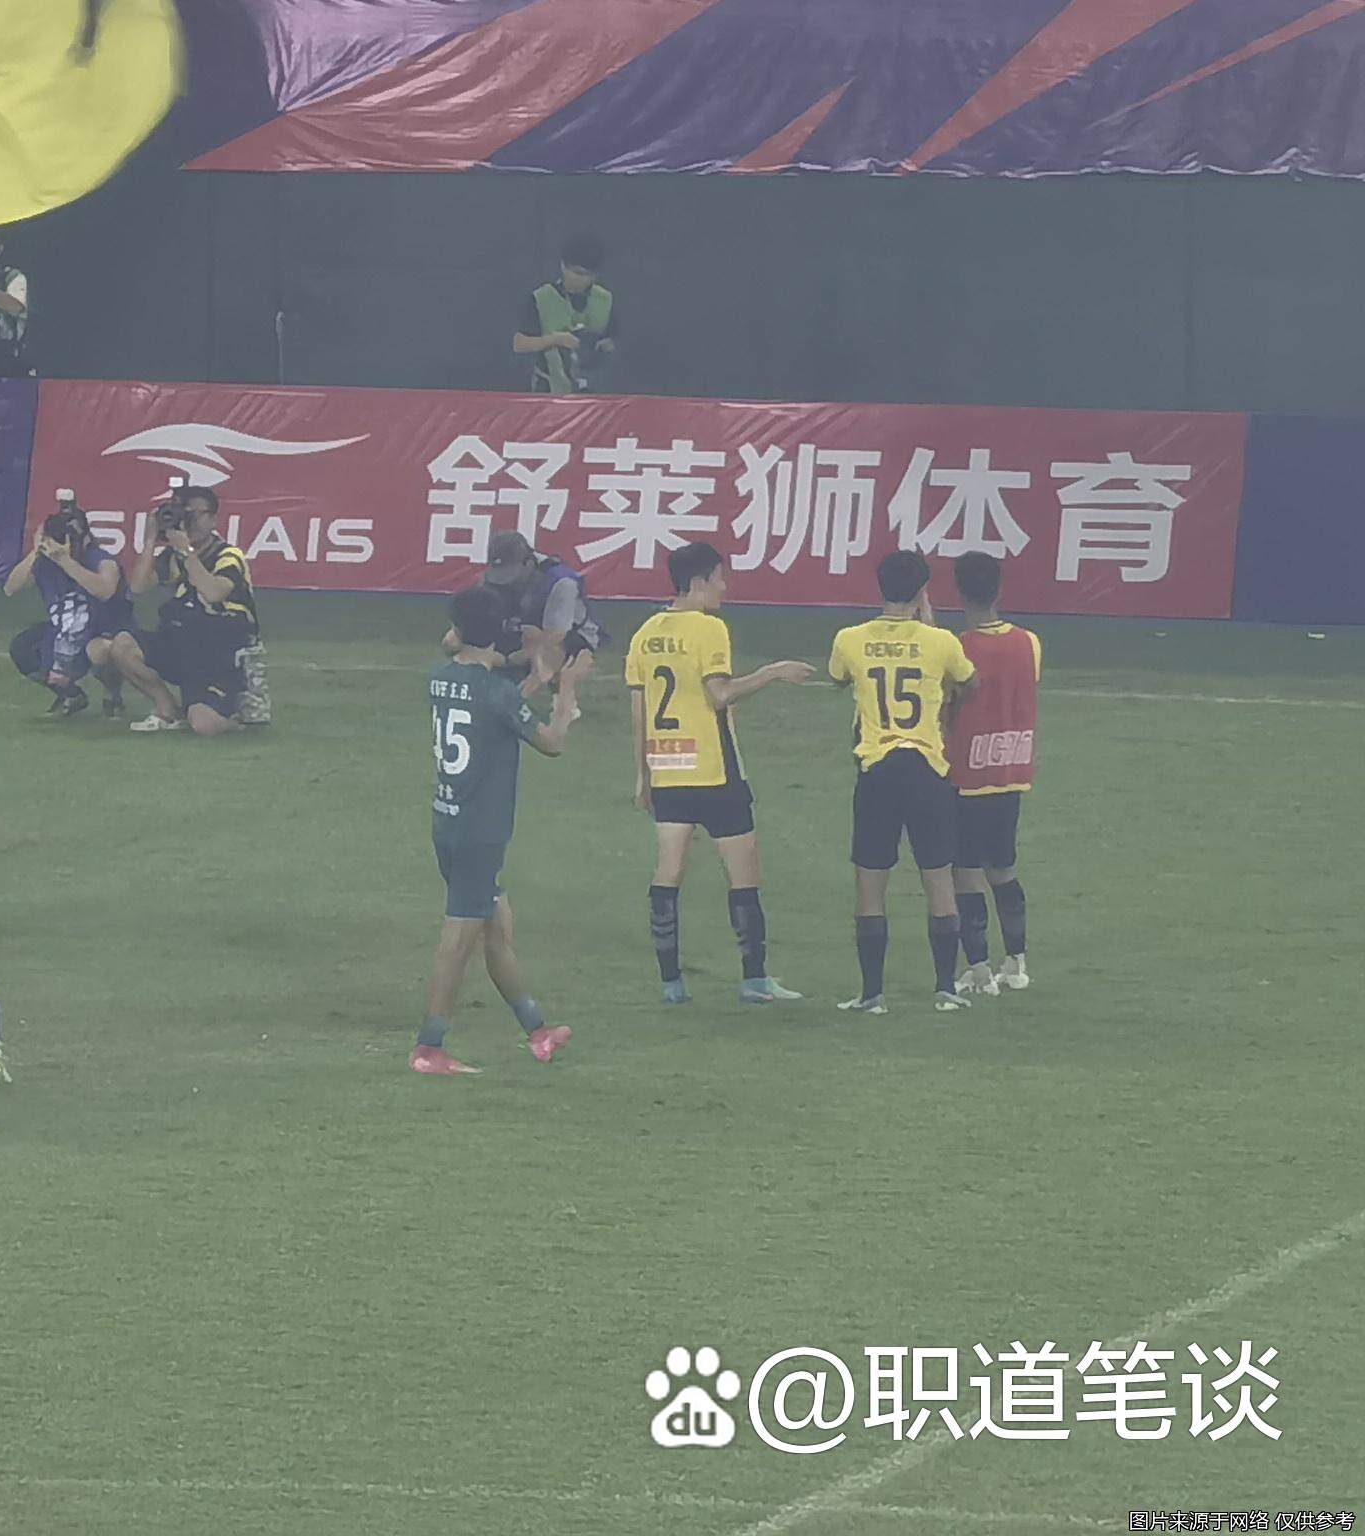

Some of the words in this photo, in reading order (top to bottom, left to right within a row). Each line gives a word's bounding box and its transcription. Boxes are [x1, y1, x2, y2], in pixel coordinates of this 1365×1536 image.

[425, 435, 1192, 584] 舒莱狮体育
[652, 664, 680, 731] 2
[867, 666, 923, 731] 15
